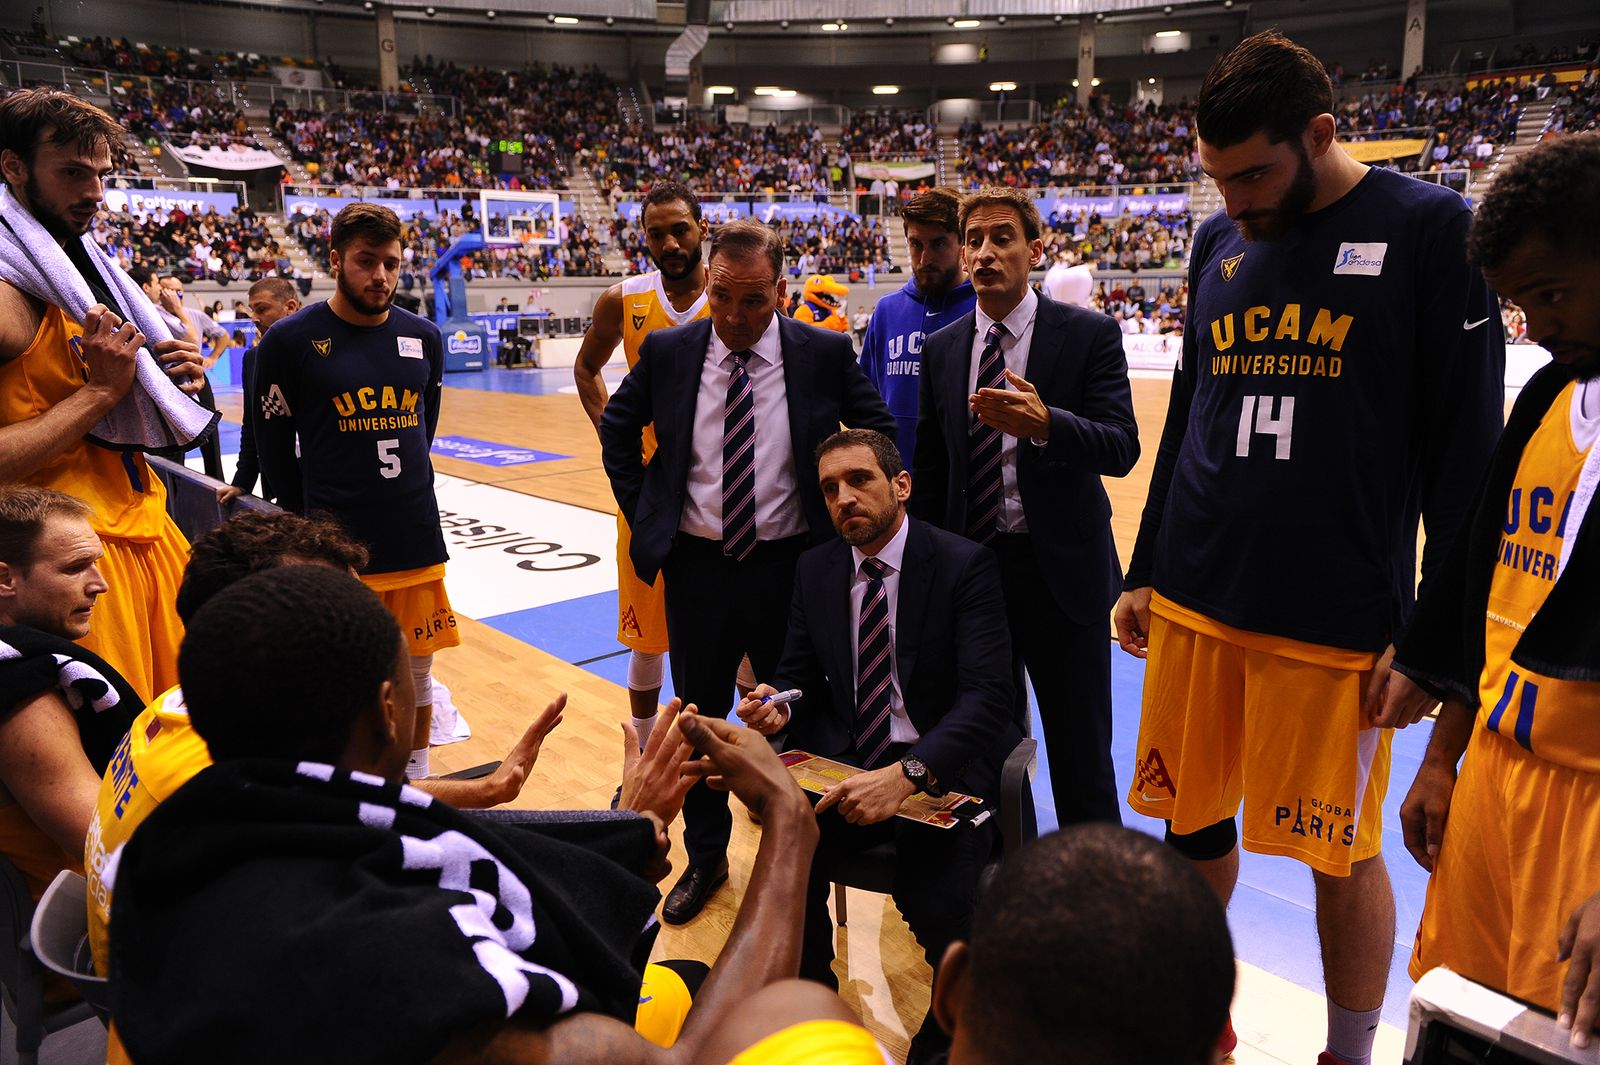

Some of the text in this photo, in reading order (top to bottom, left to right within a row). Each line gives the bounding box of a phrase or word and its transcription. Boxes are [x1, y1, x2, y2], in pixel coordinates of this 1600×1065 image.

[1408, 16, 1422, 32] A
[381, 38, 394, 53] G
[1210, 303, 1354, 352] UCAM
[888, 331, 926, 360] UC
[887, 361, 920, 376] UNIVE
[1211, 354, 1343, 378] UNIVERSIDAD
[332, 386, 419, 417] UCAM
[339, 413, 419, 432] UNIVERSIDAD
[1235, 395, 1295, 460] 14
[377, 439, 402, 479] 5
[1311, 798, 1356, 817] GLOBA
